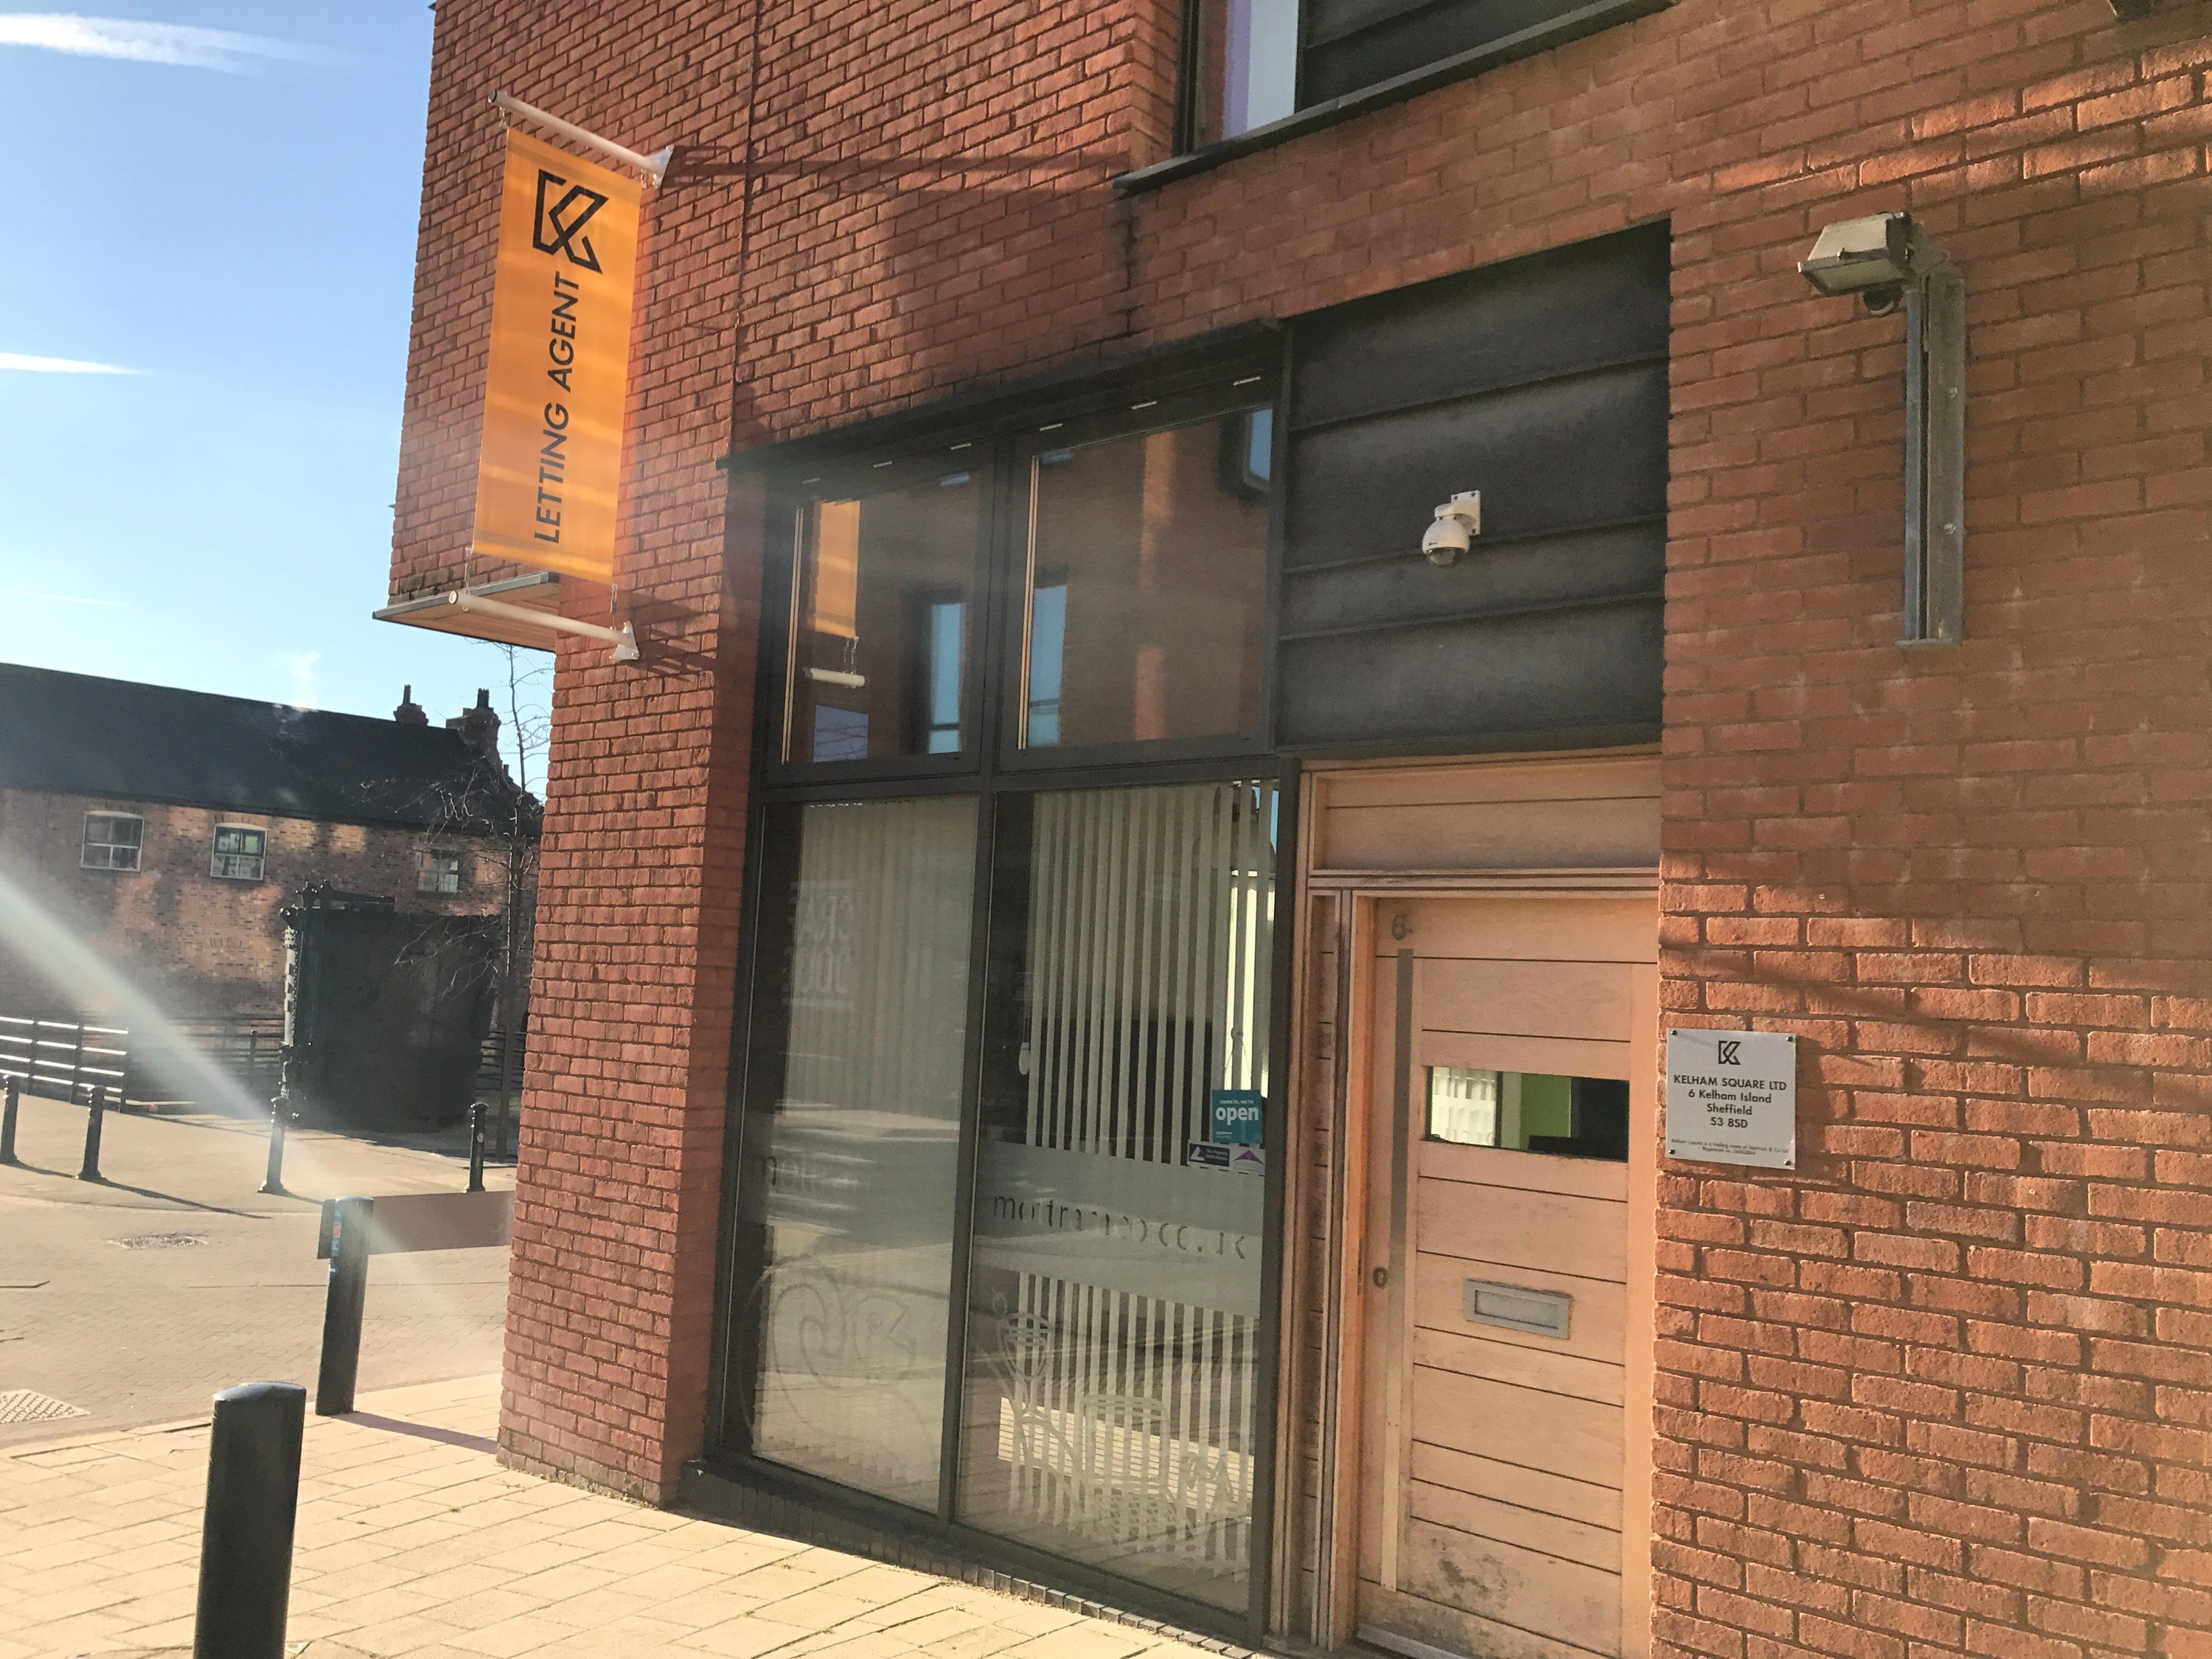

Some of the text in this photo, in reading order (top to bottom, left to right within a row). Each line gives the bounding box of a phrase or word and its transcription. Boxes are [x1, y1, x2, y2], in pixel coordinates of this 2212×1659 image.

[534, 271, 580, 544] LETTING AGENT
[1674, 1074, 1787, 1091] KELHAM SQUARE LTD
[1688, 1088, 1772, 1103] 6 Kelham Island
[1216, 1107, 1259, 1126] open
[1707, 1102, 1753, 1116] Sheffield
[1711, 1116, 1748, 1128] S3 8SD
